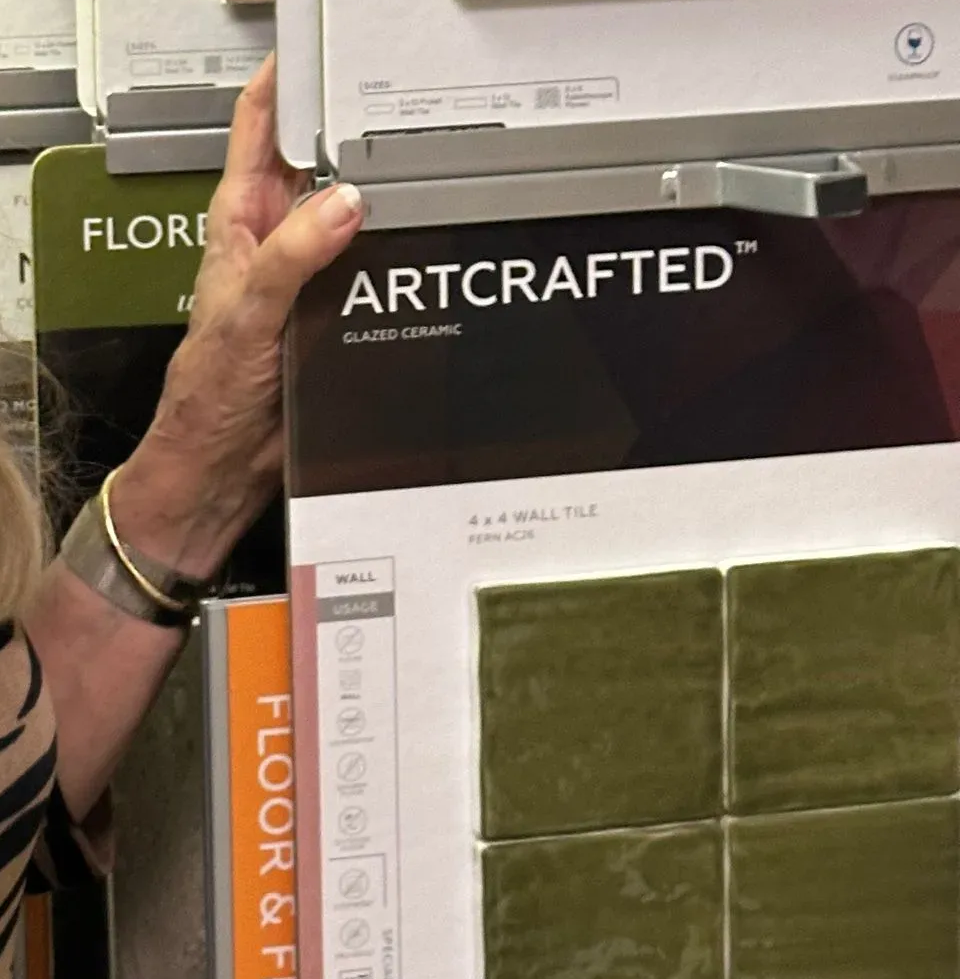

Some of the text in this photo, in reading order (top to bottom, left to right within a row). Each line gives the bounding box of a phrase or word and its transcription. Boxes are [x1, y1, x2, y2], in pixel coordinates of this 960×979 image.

[14, 195, 30, 207] FL
[82, 212, 208, 252] FLORE
[342, 323, 464, 344] GLAZED CERAMIC
[468, 503, 598, 527] 4 x 4 WALL TILE
[468, 529, 536, 545] FERN AC26
[334, 572, 376, 585] WALL
[333, 601, 378, 615] USAGE
[256, 693, 295, 877] FLOOR
[260, 892, 296, 929] &
